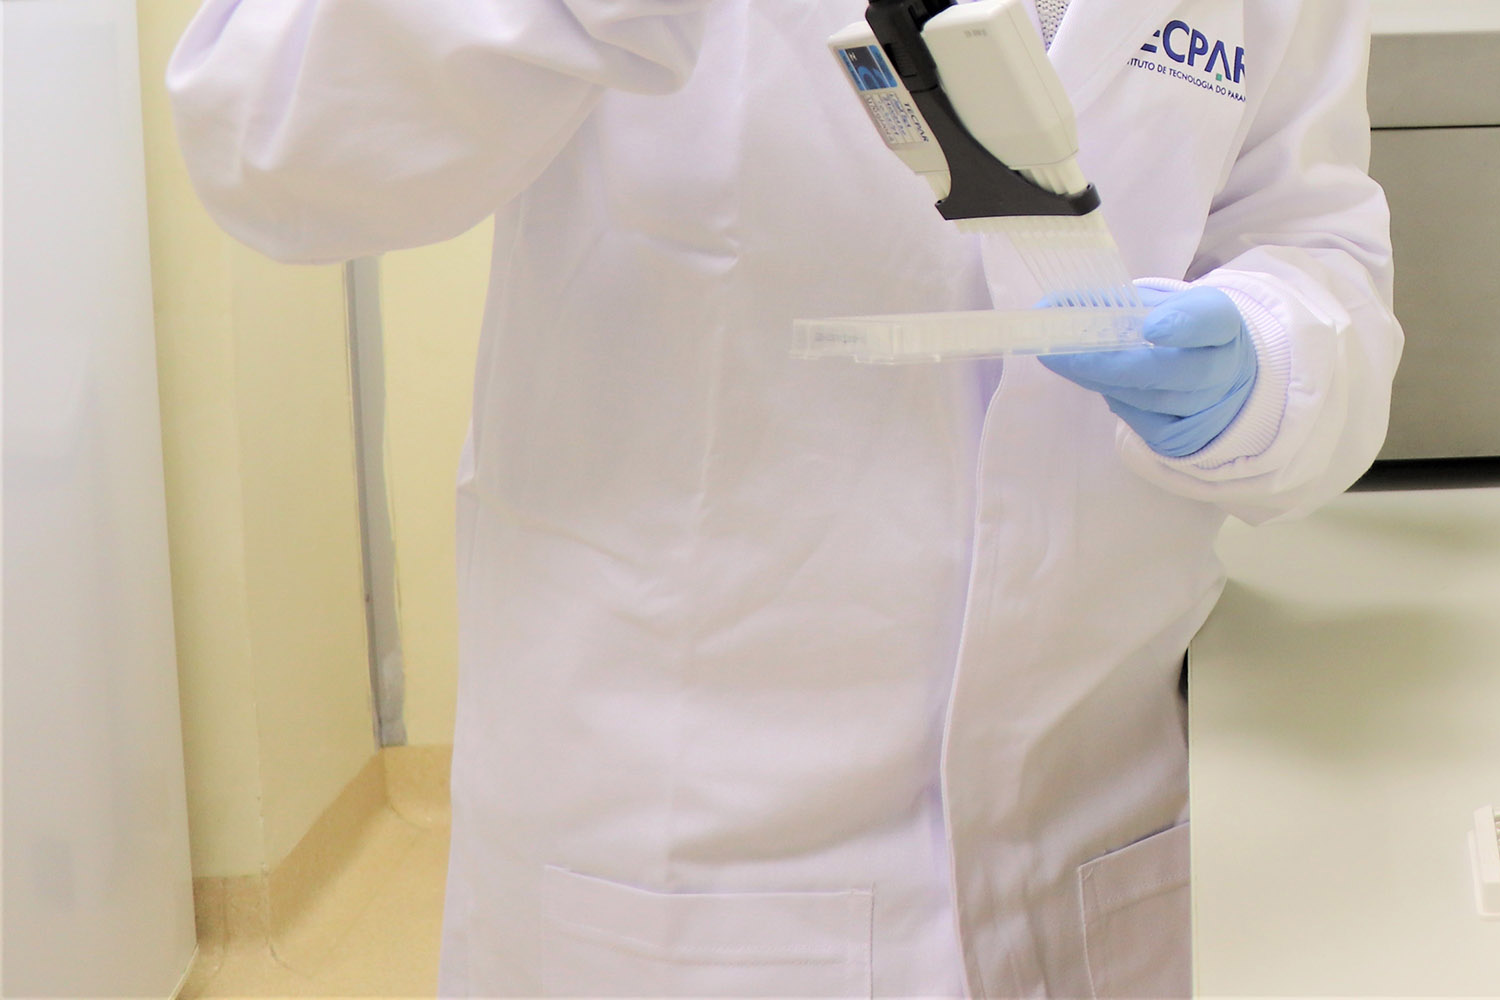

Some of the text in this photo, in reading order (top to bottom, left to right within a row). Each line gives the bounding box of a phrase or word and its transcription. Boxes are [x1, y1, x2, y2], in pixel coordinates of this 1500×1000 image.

[1157, 65, 1167, 75] DE
[1168, 68, 1214, 92] TECNOLOGIA
[1215, 84, 1227, 96] DO
